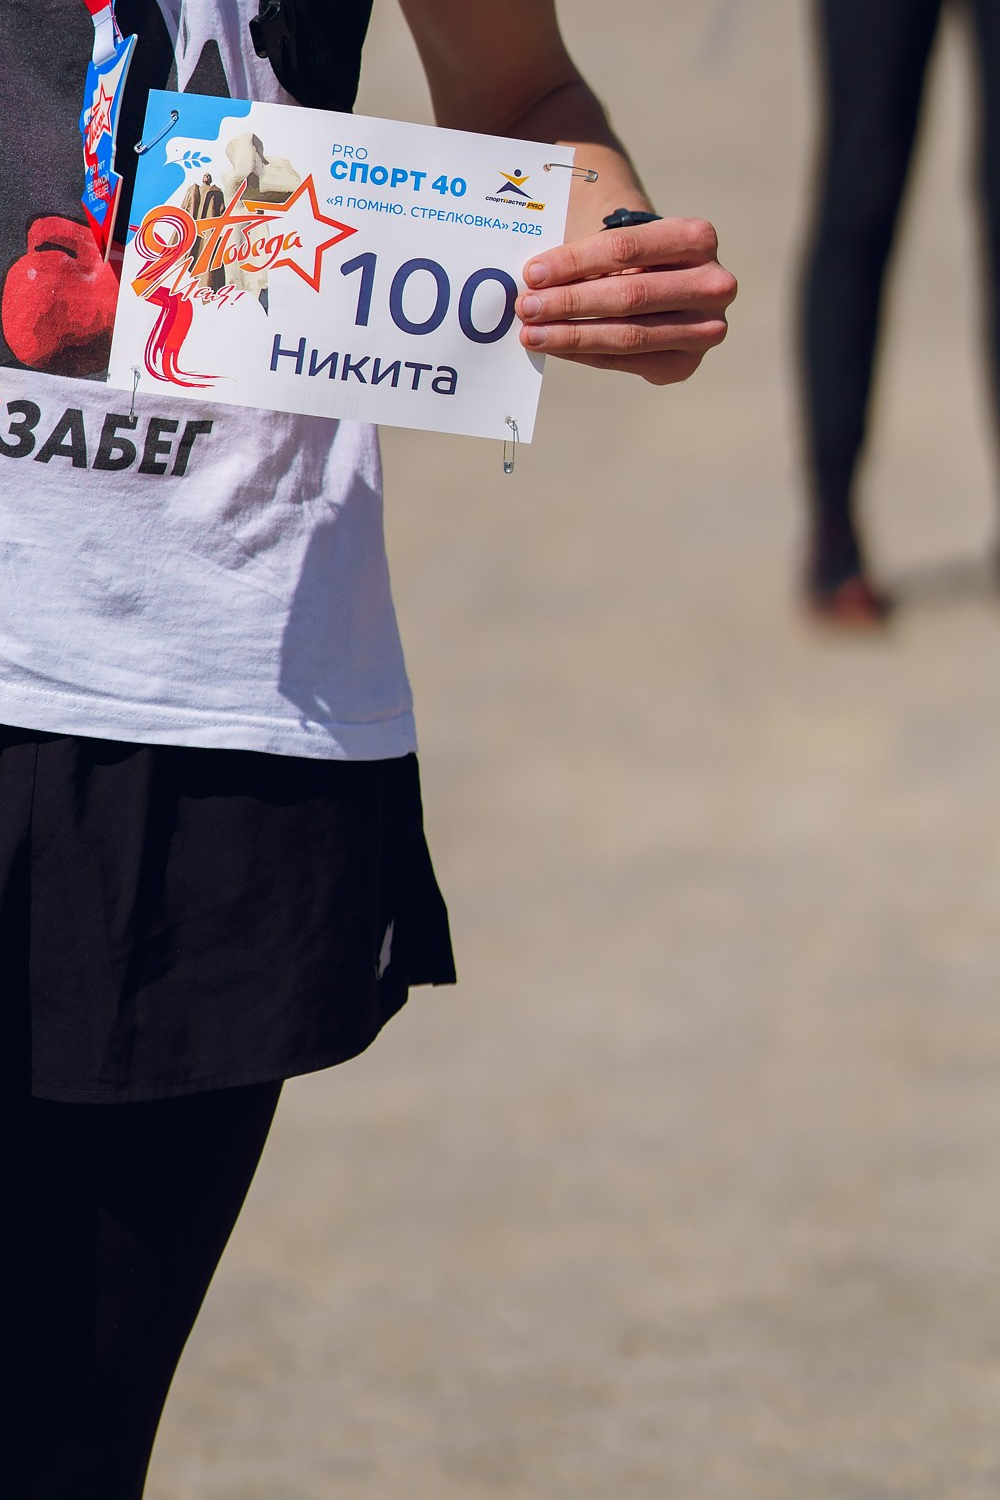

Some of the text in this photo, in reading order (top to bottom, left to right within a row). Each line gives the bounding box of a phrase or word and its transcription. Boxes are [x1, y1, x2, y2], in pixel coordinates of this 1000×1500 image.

[331, 143, 368, 160] PRO
[330, 160, 467, 198] СПОРТ 40
[326, 195, 543, 236] «Я ПОМНЮ. СТРЕЛКОВКА» 2025
[527, 202, 545, 211] PRO
[190, 196, 304, 278] Победа
[340, 251, 518, 345] 100
[269, 333, 459, 397] Никита
